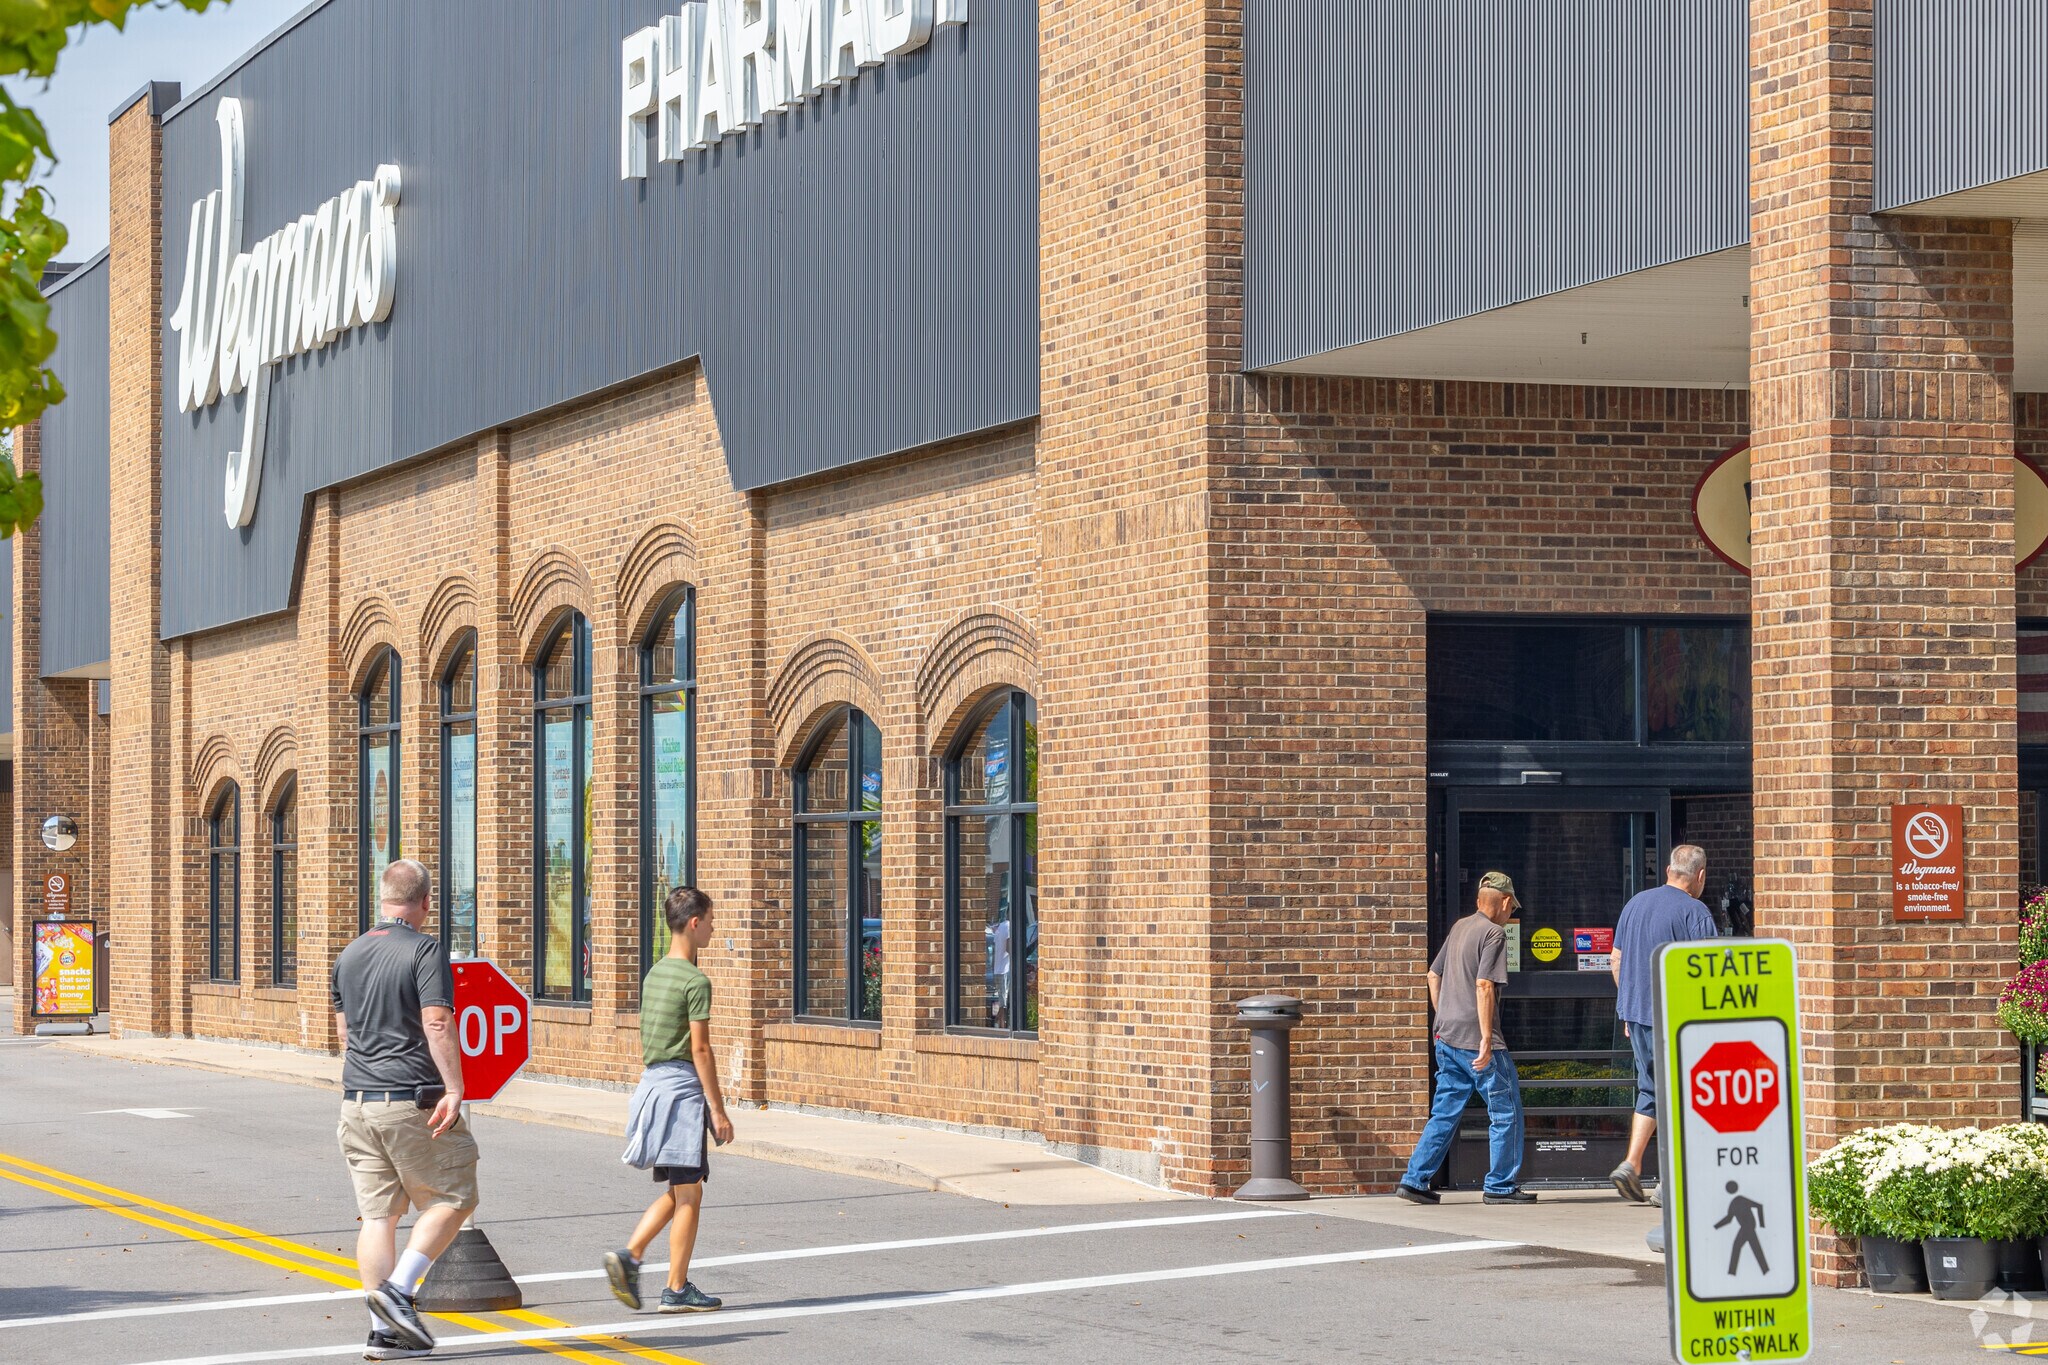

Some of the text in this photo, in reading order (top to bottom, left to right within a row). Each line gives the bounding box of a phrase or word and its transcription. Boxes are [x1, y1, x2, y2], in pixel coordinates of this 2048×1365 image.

[170, 97, 401, 529] Wegmans
[1899, 859, 1956, 881] Wegmans
[1896, 882, 1902, 890] is
[1912, 881, 1960, 891] tobacco-free/
[1907, 892, 1948, 901] smoke-free
[1904, 903, 1952, 912] environment.
[59, 967, 91, 976] snacks
[1687, 951, 1772, 978] STATE
[60, 975, 74, 983] that
[60, 983, 90, 991] time and
[60, 991, 84, 1000] money
[1702, 984, 1758, 1010] LAW
[459, 1005, 521, 1056] OP
[1695, 1068, 1774, 1106] STOP
[1717, 1146, 1758, 1167] FOR
[1714, 1308, 1775, 1329] WITHIN
[1691, 1333, 1799, 1357] CROSSWALK
